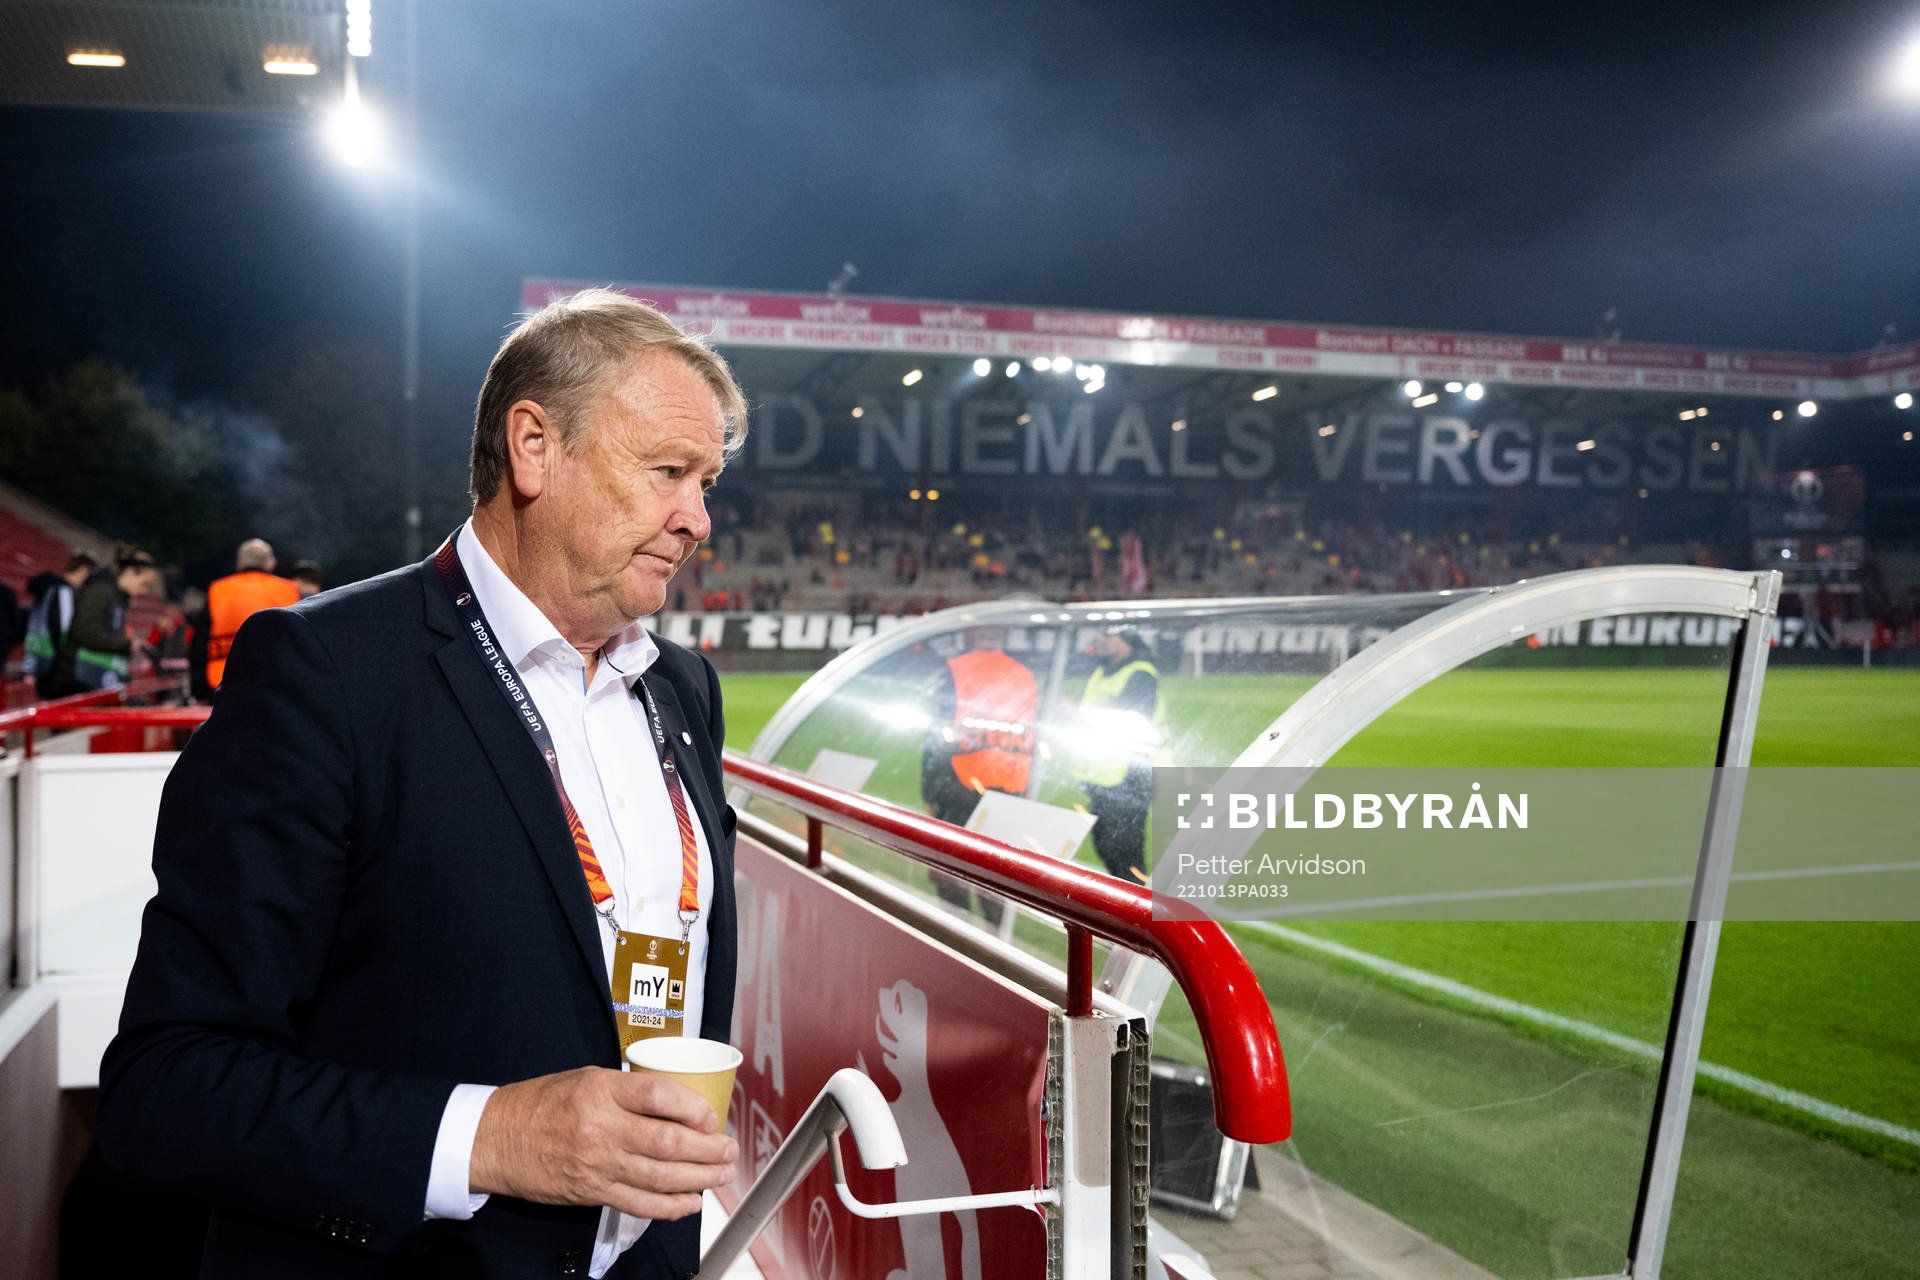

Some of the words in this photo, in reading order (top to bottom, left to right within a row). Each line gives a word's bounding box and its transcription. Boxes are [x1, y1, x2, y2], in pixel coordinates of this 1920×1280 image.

[857, 399, 1278, 480] NIEMALS
[1307, 411, 1780, 493] VERGESSEN
[471, 619, 502, 662] LEAGUE
[495, 660, 525, 702] EUROPA
[520, 698, 542, 732] UEFA
[653, 716, 665, 744] UEFA
[634, 977, 665, 998] mY
[632, 1013, 662, 1026] 2021-24
